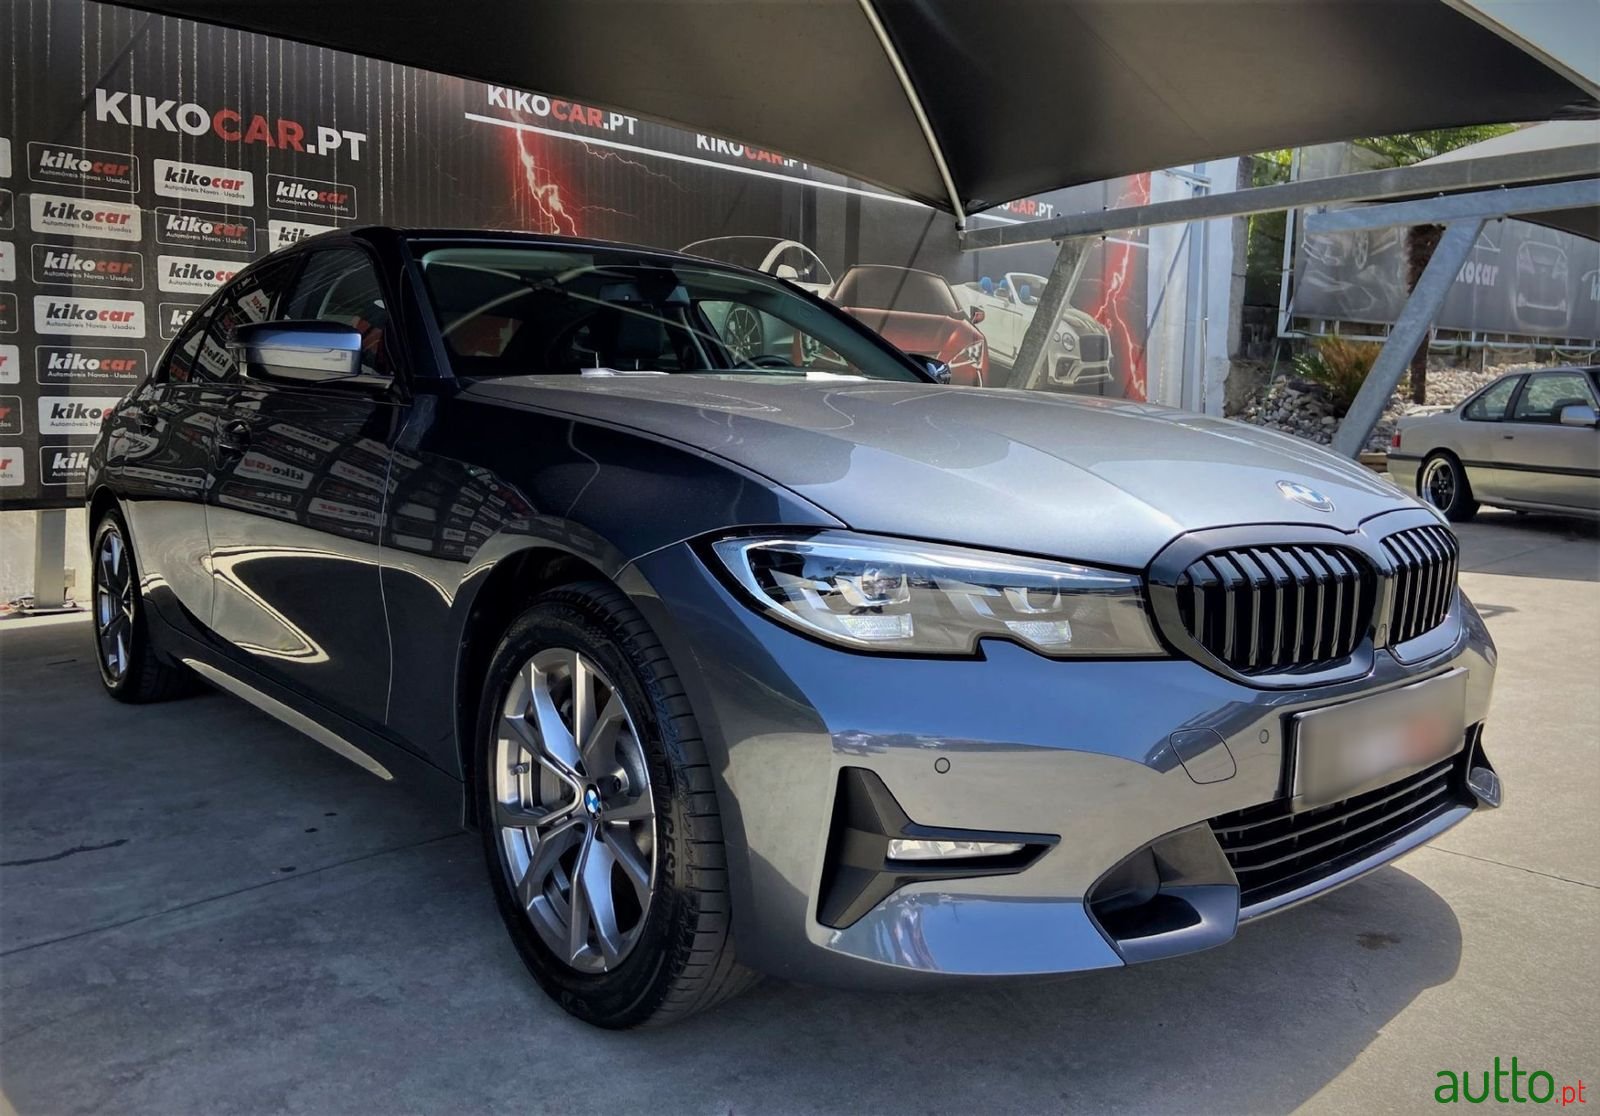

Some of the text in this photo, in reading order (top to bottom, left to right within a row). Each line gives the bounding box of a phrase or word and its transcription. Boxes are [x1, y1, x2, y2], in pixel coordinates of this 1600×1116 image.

[487, 84, 639, 135] KIKOCAR.PT
[95, 88, 367, 161] KIKOCAR.PT
[40, 150, 129, 176] kikocar
[164, 167, 244, 191] kikocar
[276, 181, 348, 203] kikocar
[42, 201, 131, 225] kikocar
[997, 199, 1053, 219] OCAR.PT
[166, 214, 247, 238] kikocar
[44, 252, 133, 274] kikocar
[169, 262, 236, 281] kikoca
[1456, 261, 1498, 287] kocar
[46, 303, 135, 322] kikocar
[47, 352, 137, 371] kikocar
[50, 403, 113, 419] kikoc
